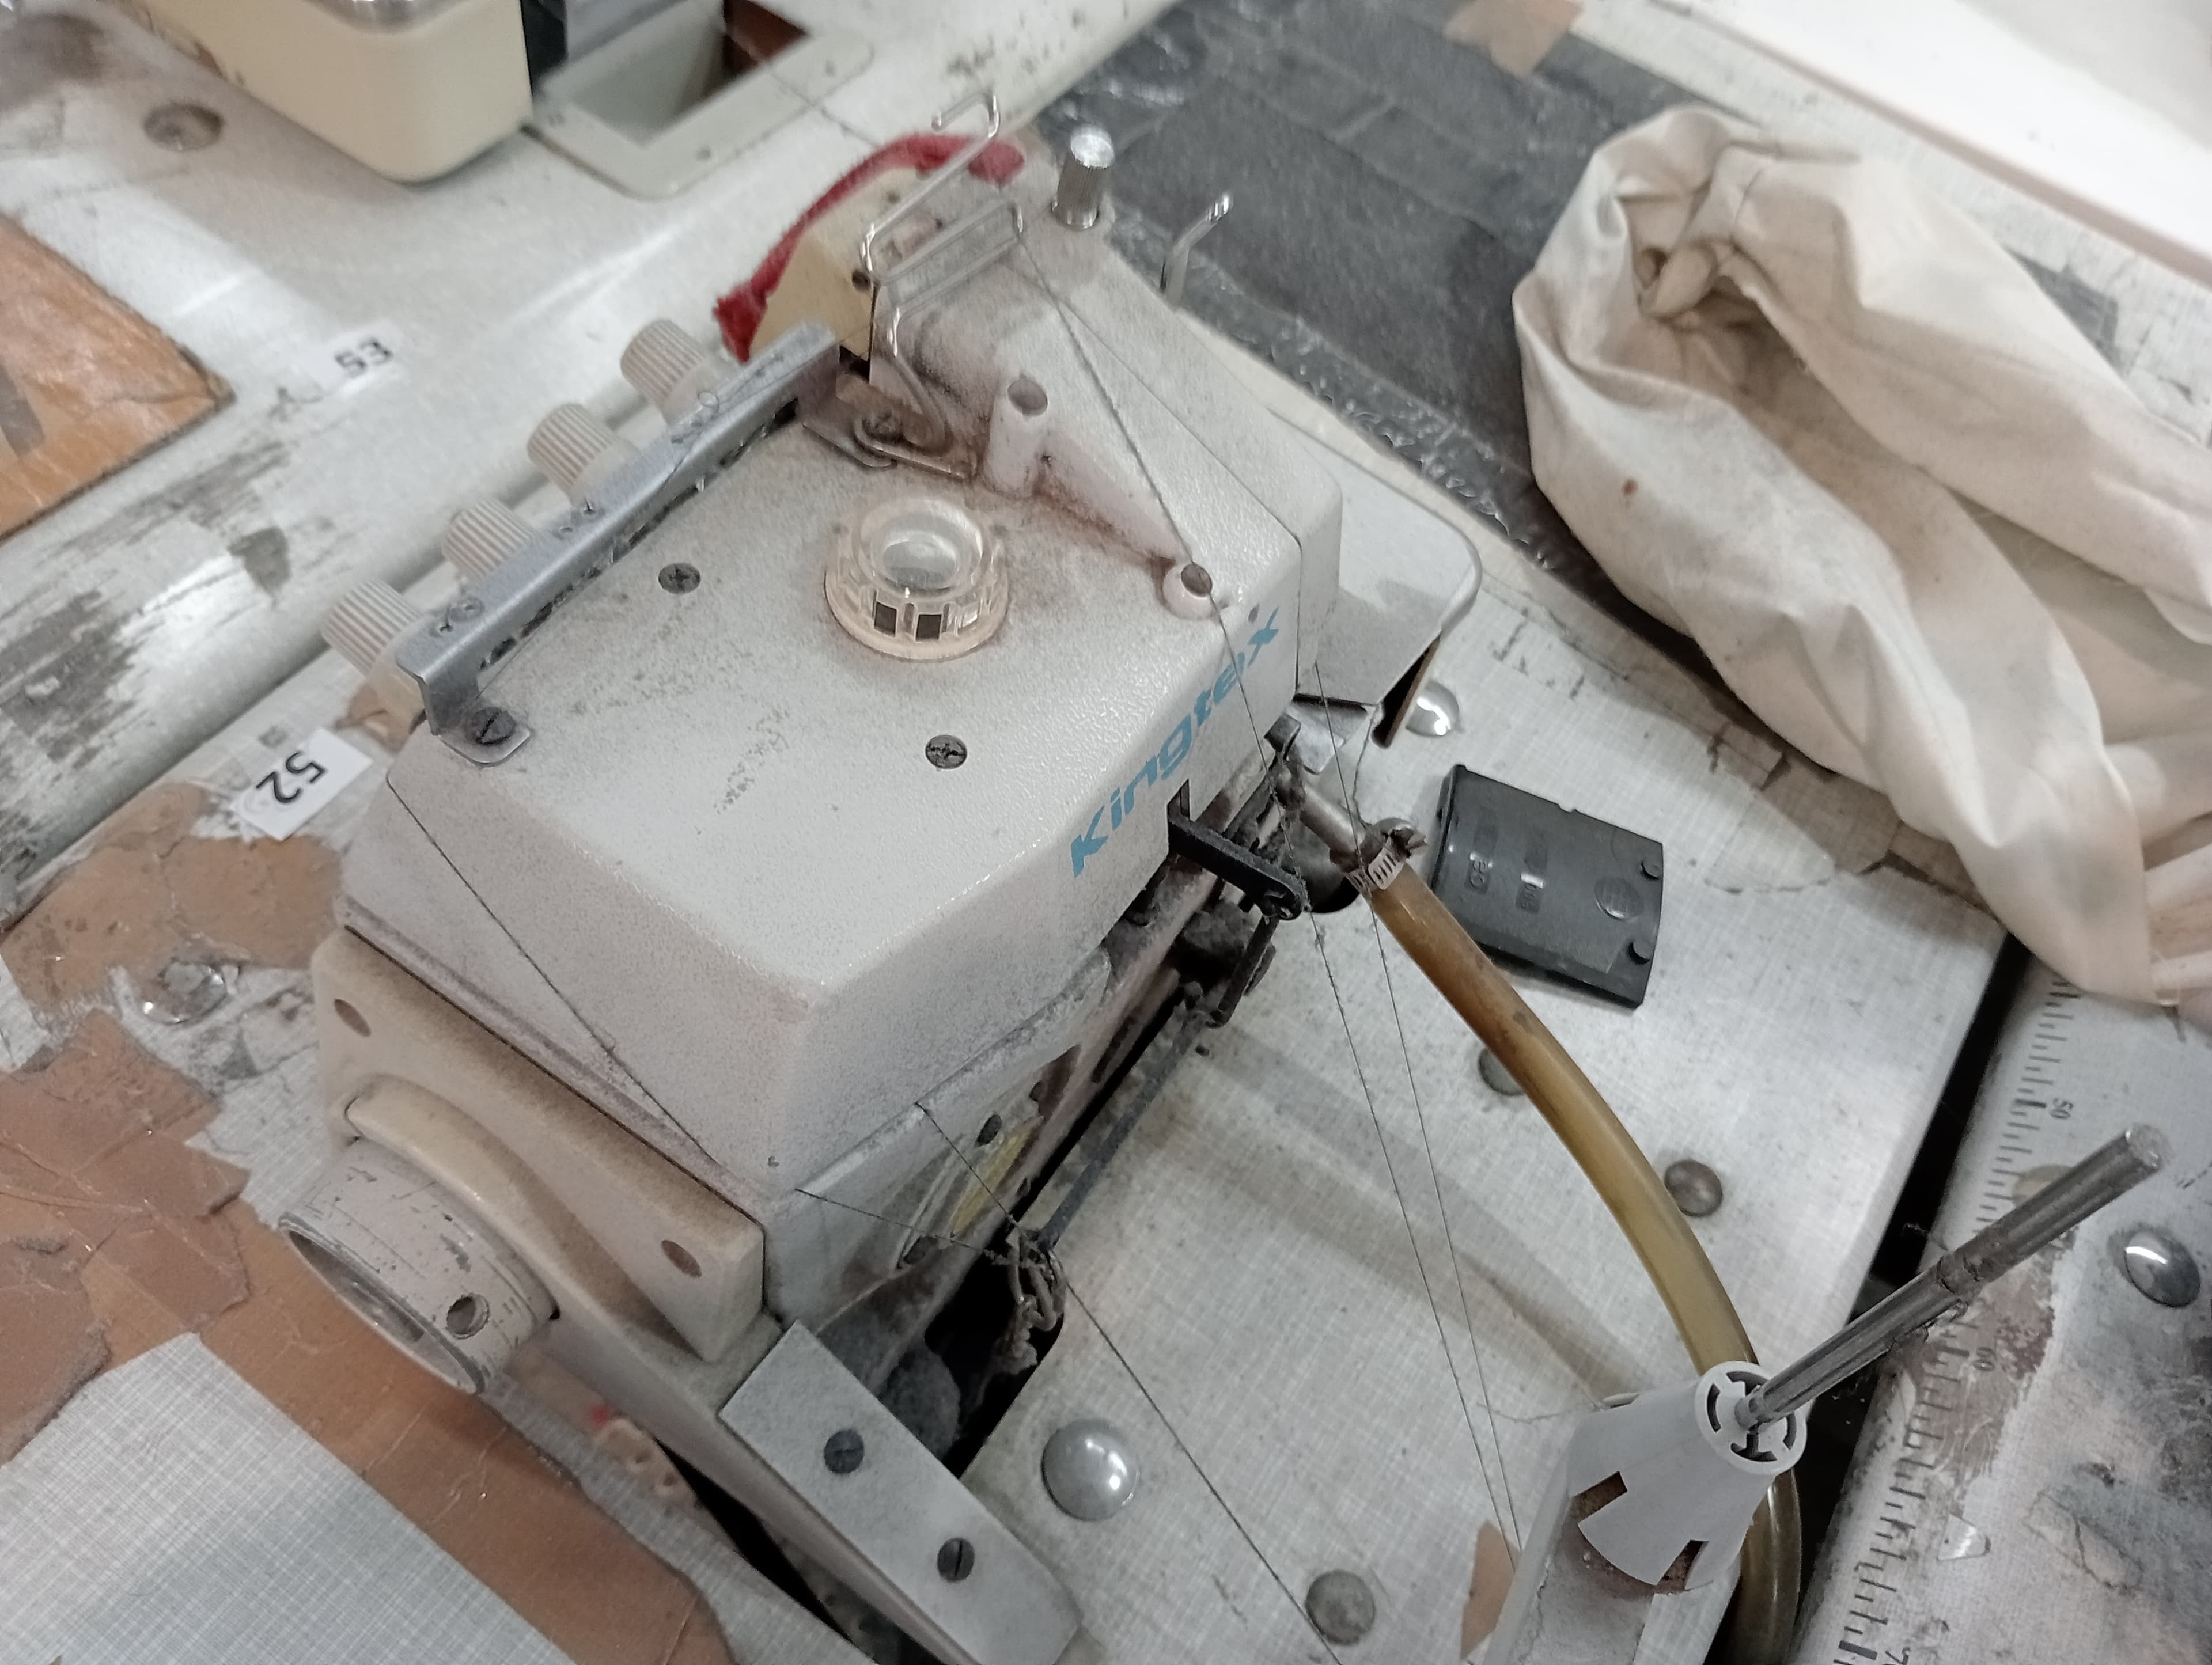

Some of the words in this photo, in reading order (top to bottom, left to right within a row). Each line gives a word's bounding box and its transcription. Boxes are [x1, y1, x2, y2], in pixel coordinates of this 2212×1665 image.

[334, 335, 394, 378] 53
[1070, 606, 1279, 878] Kingtex
[255, 750, 327, 804] 52
[2049, 1097, 2074, 1120] 50
